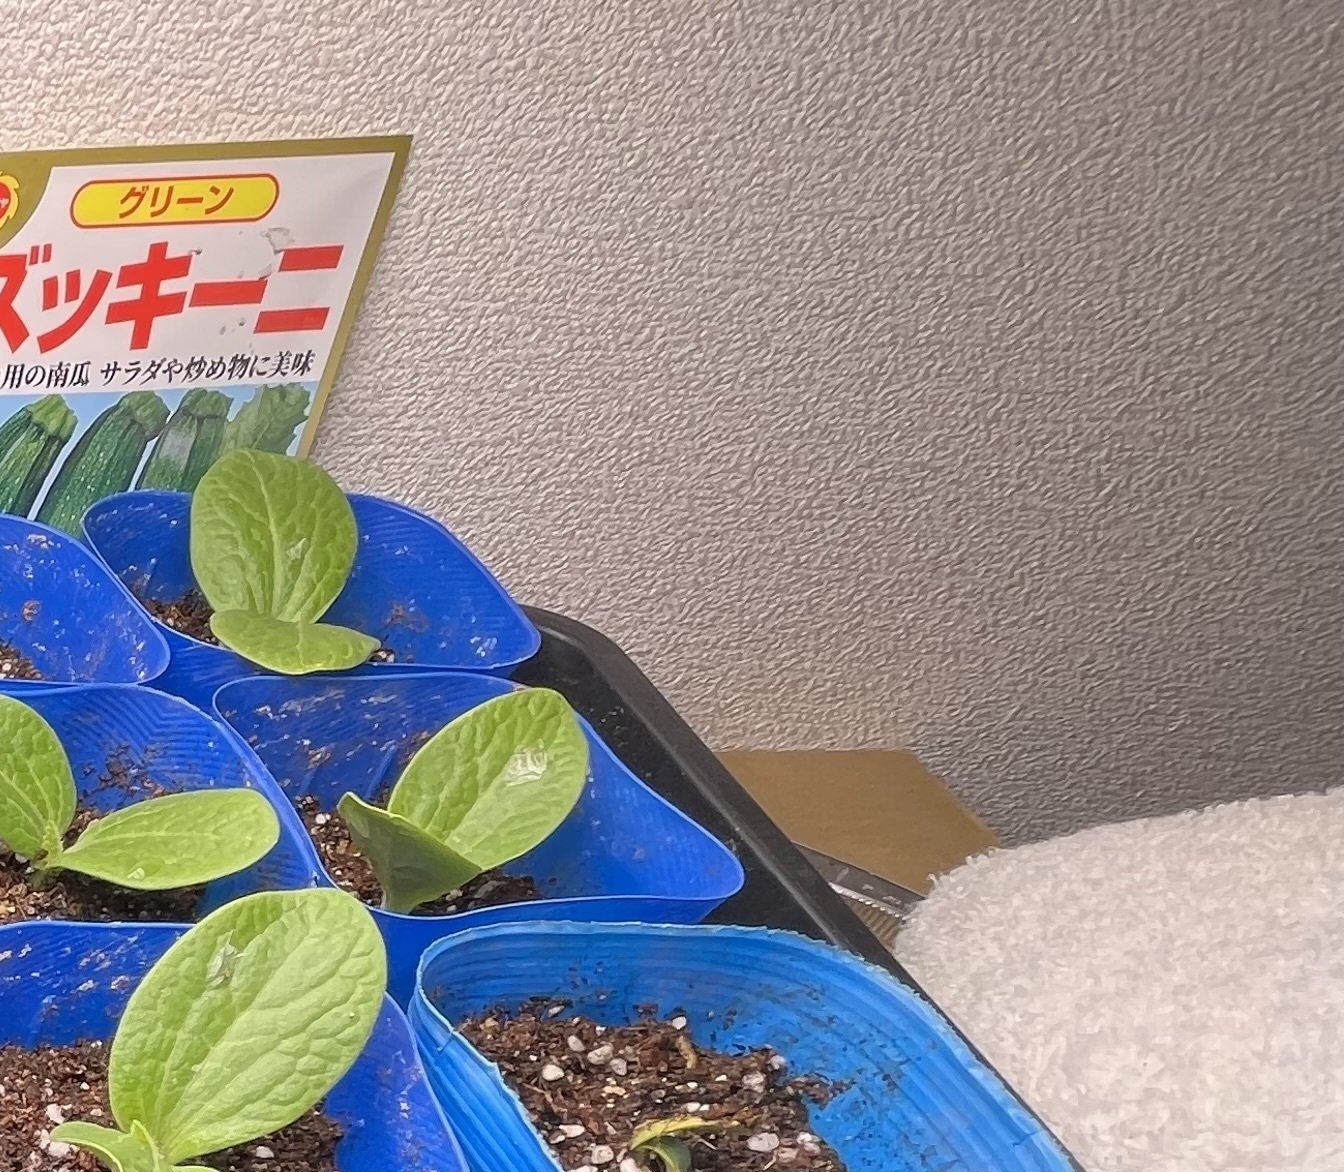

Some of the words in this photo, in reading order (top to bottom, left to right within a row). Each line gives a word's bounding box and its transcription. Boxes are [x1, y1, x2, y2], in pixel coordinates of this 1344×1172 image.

[118, 184, 235, 219] グリーン
[99, 349, 317, 387] サラダや炒め物に美味
